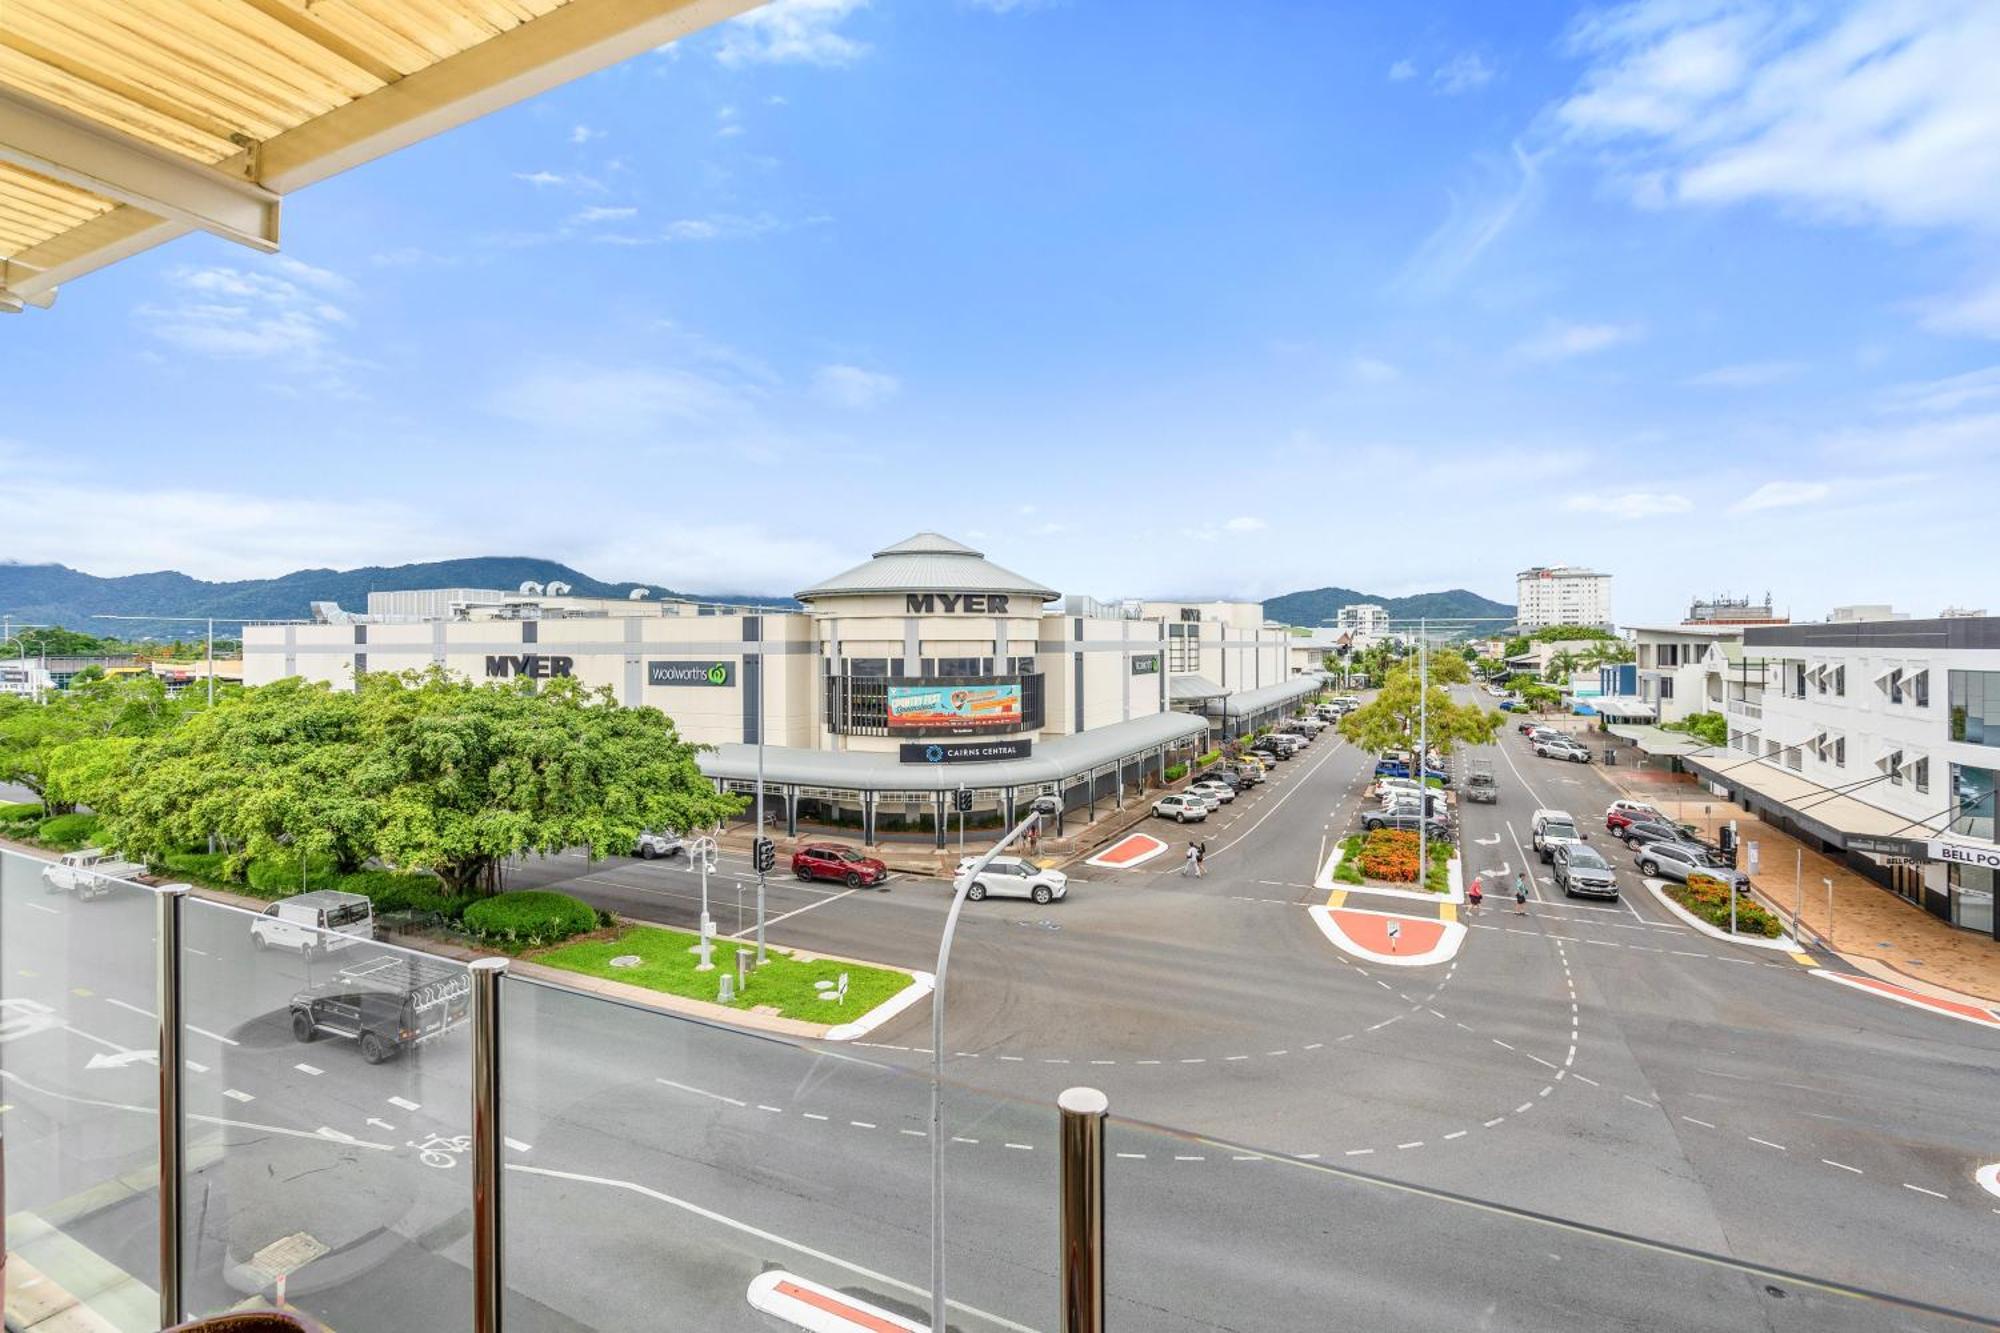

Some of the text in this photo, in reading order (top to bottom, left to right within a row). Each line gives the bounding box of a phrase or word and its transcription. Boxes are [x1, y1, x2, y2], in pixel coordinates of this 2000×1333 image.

[906, 594, 1009, 613] MYER
[485, 655, 574, 678] MYER
[652, 666, 707, 681] woolworths
[947, 746, 1017, 757] CAIRNS CENTRAL
[1942, 848, 1974, 862] BELL
